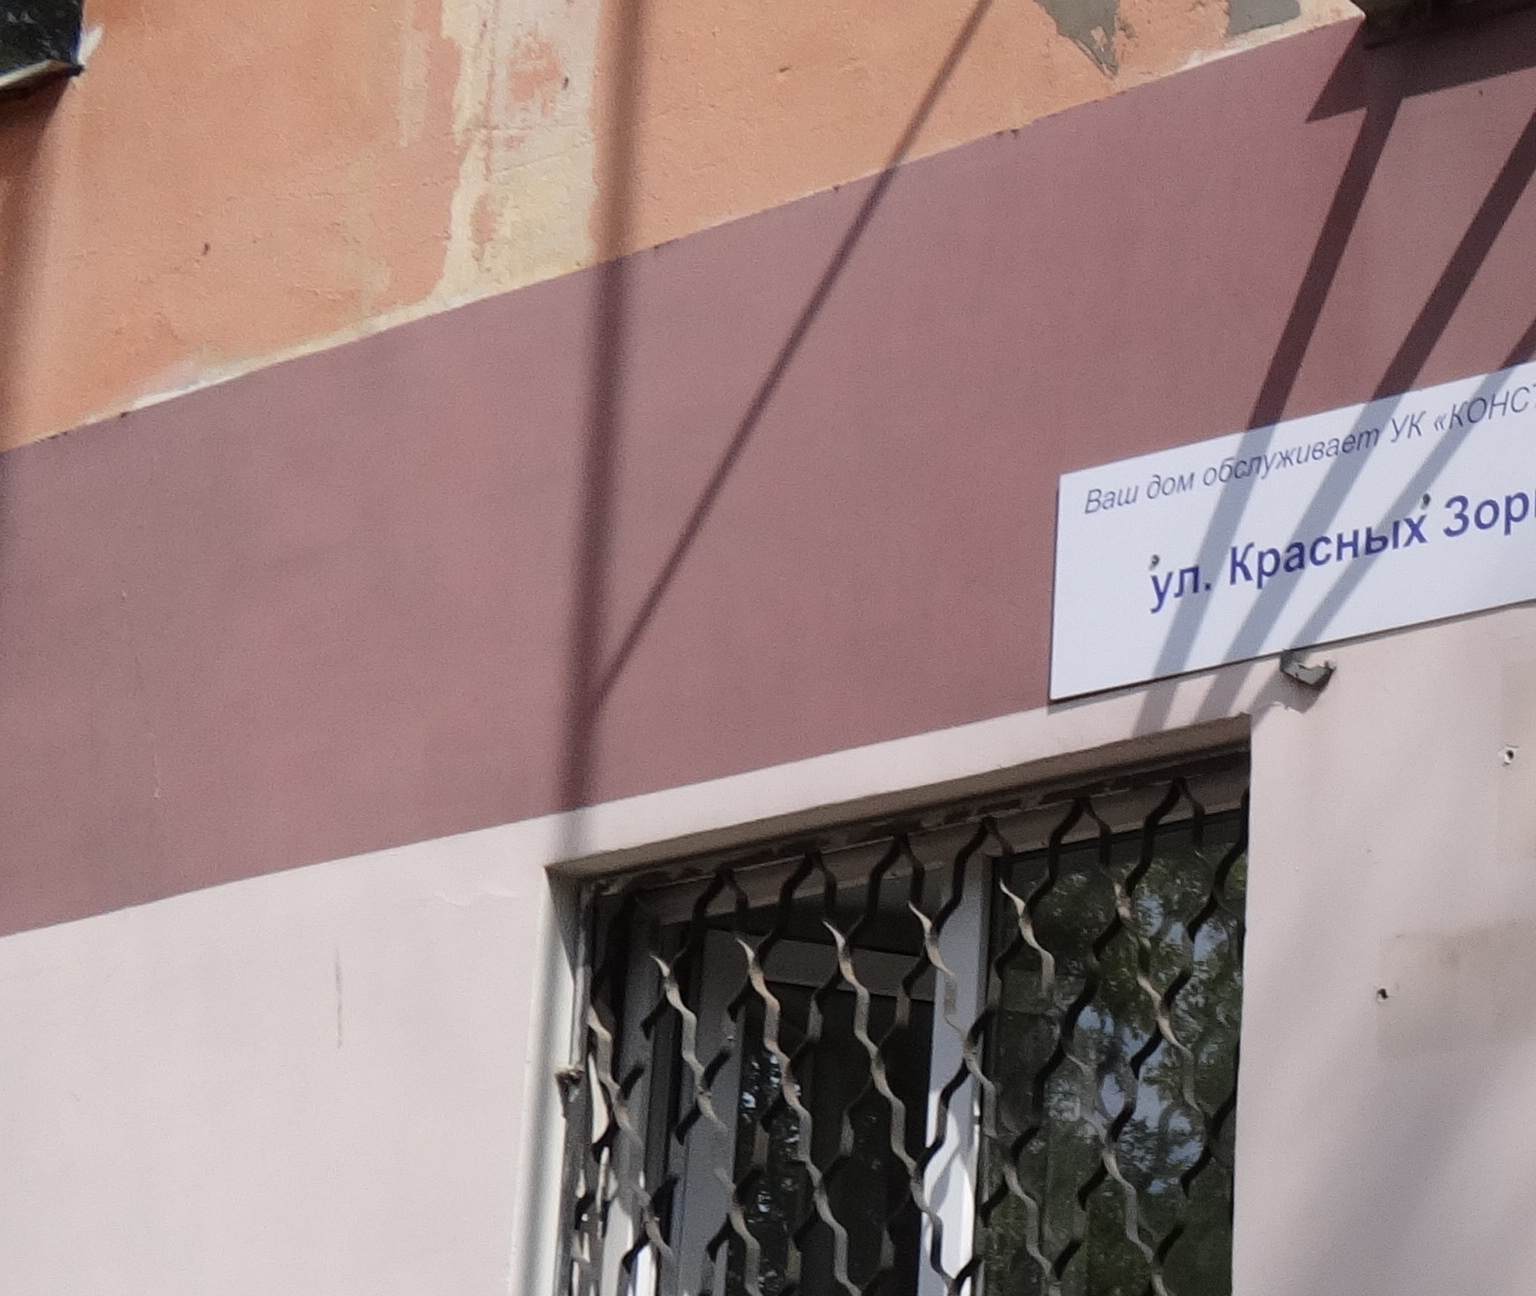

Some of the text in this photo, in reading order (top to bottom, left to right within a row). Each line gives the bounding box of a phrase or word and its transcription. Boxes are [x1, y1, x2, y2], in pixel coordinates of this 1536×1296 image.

[1084, 485, 1140, 514] Ваш
[1146, 472, 1195, 500] дом
[1203, 427, 1379, 486] обслуживает
[1390, 411, 1426, 443] УК
[1150, 564, 1212, 613] ул.
[1229, 513, 1429, 590] Красных
